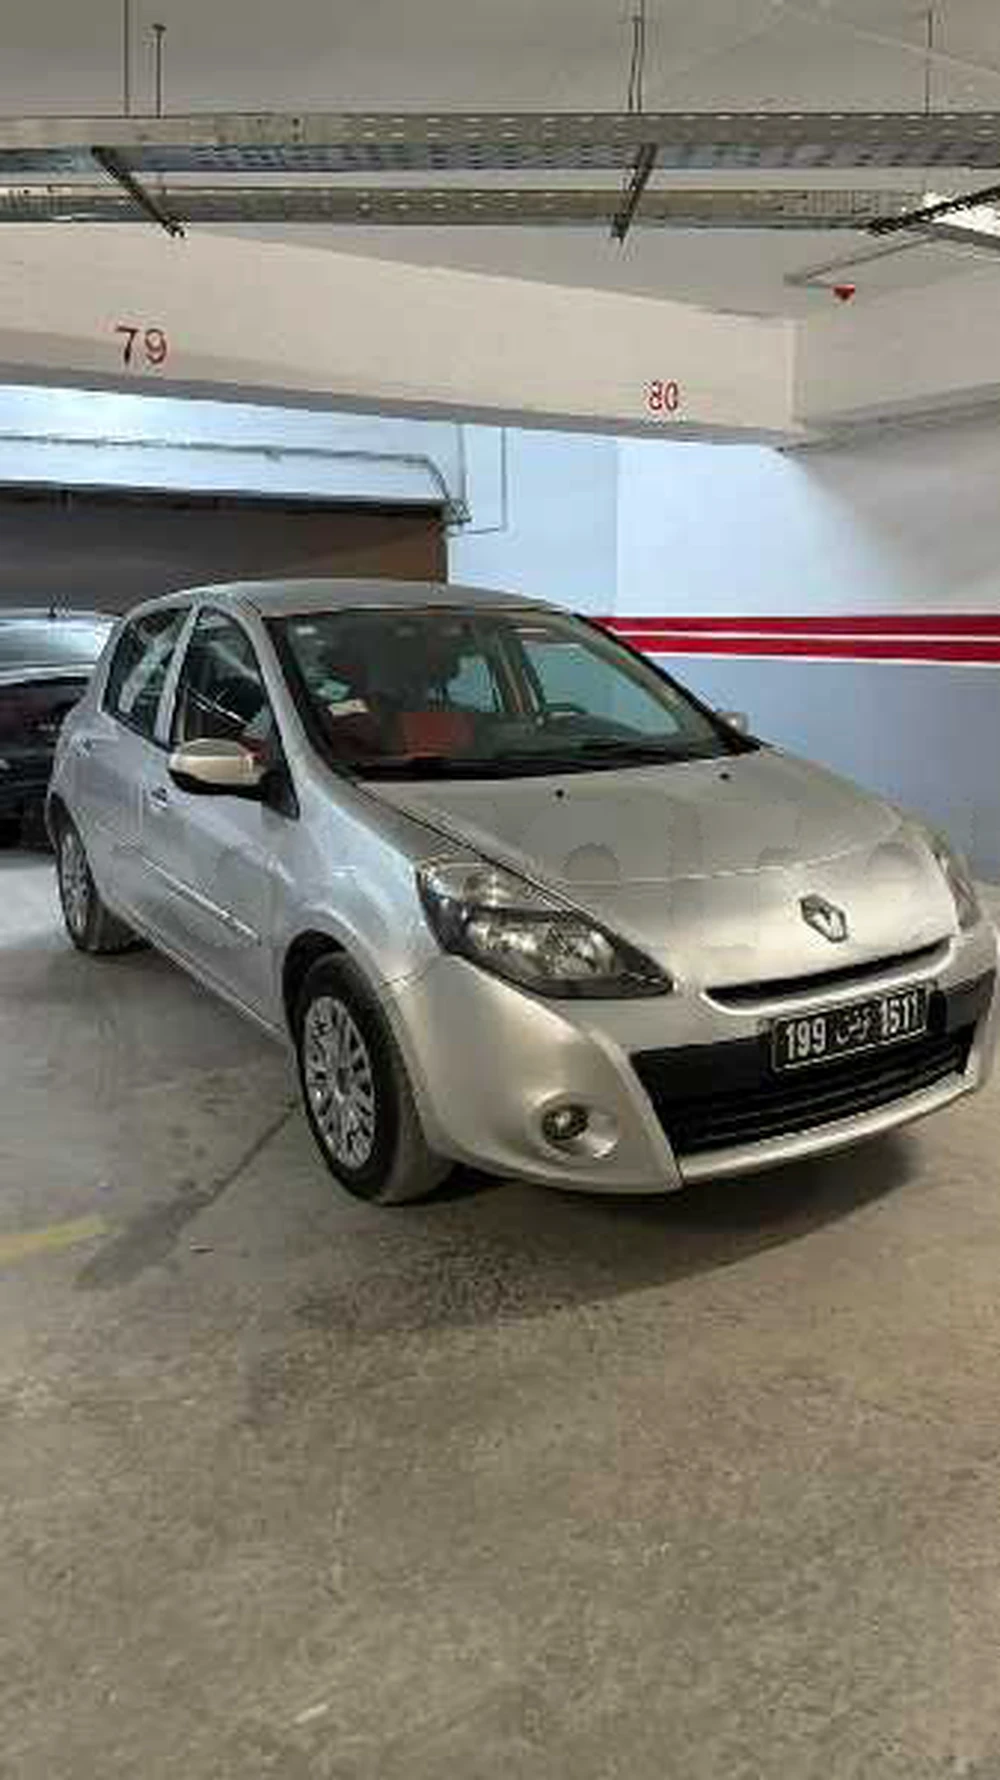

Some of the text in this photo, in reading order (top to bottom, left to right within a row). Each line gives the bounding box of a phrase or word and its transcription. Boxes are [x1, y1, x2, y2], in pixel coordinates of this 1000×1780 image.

[115, 326, 167, 365] 79
[648, 381, 679, 411] 80
[786, 1018, 826, 1060] 199
